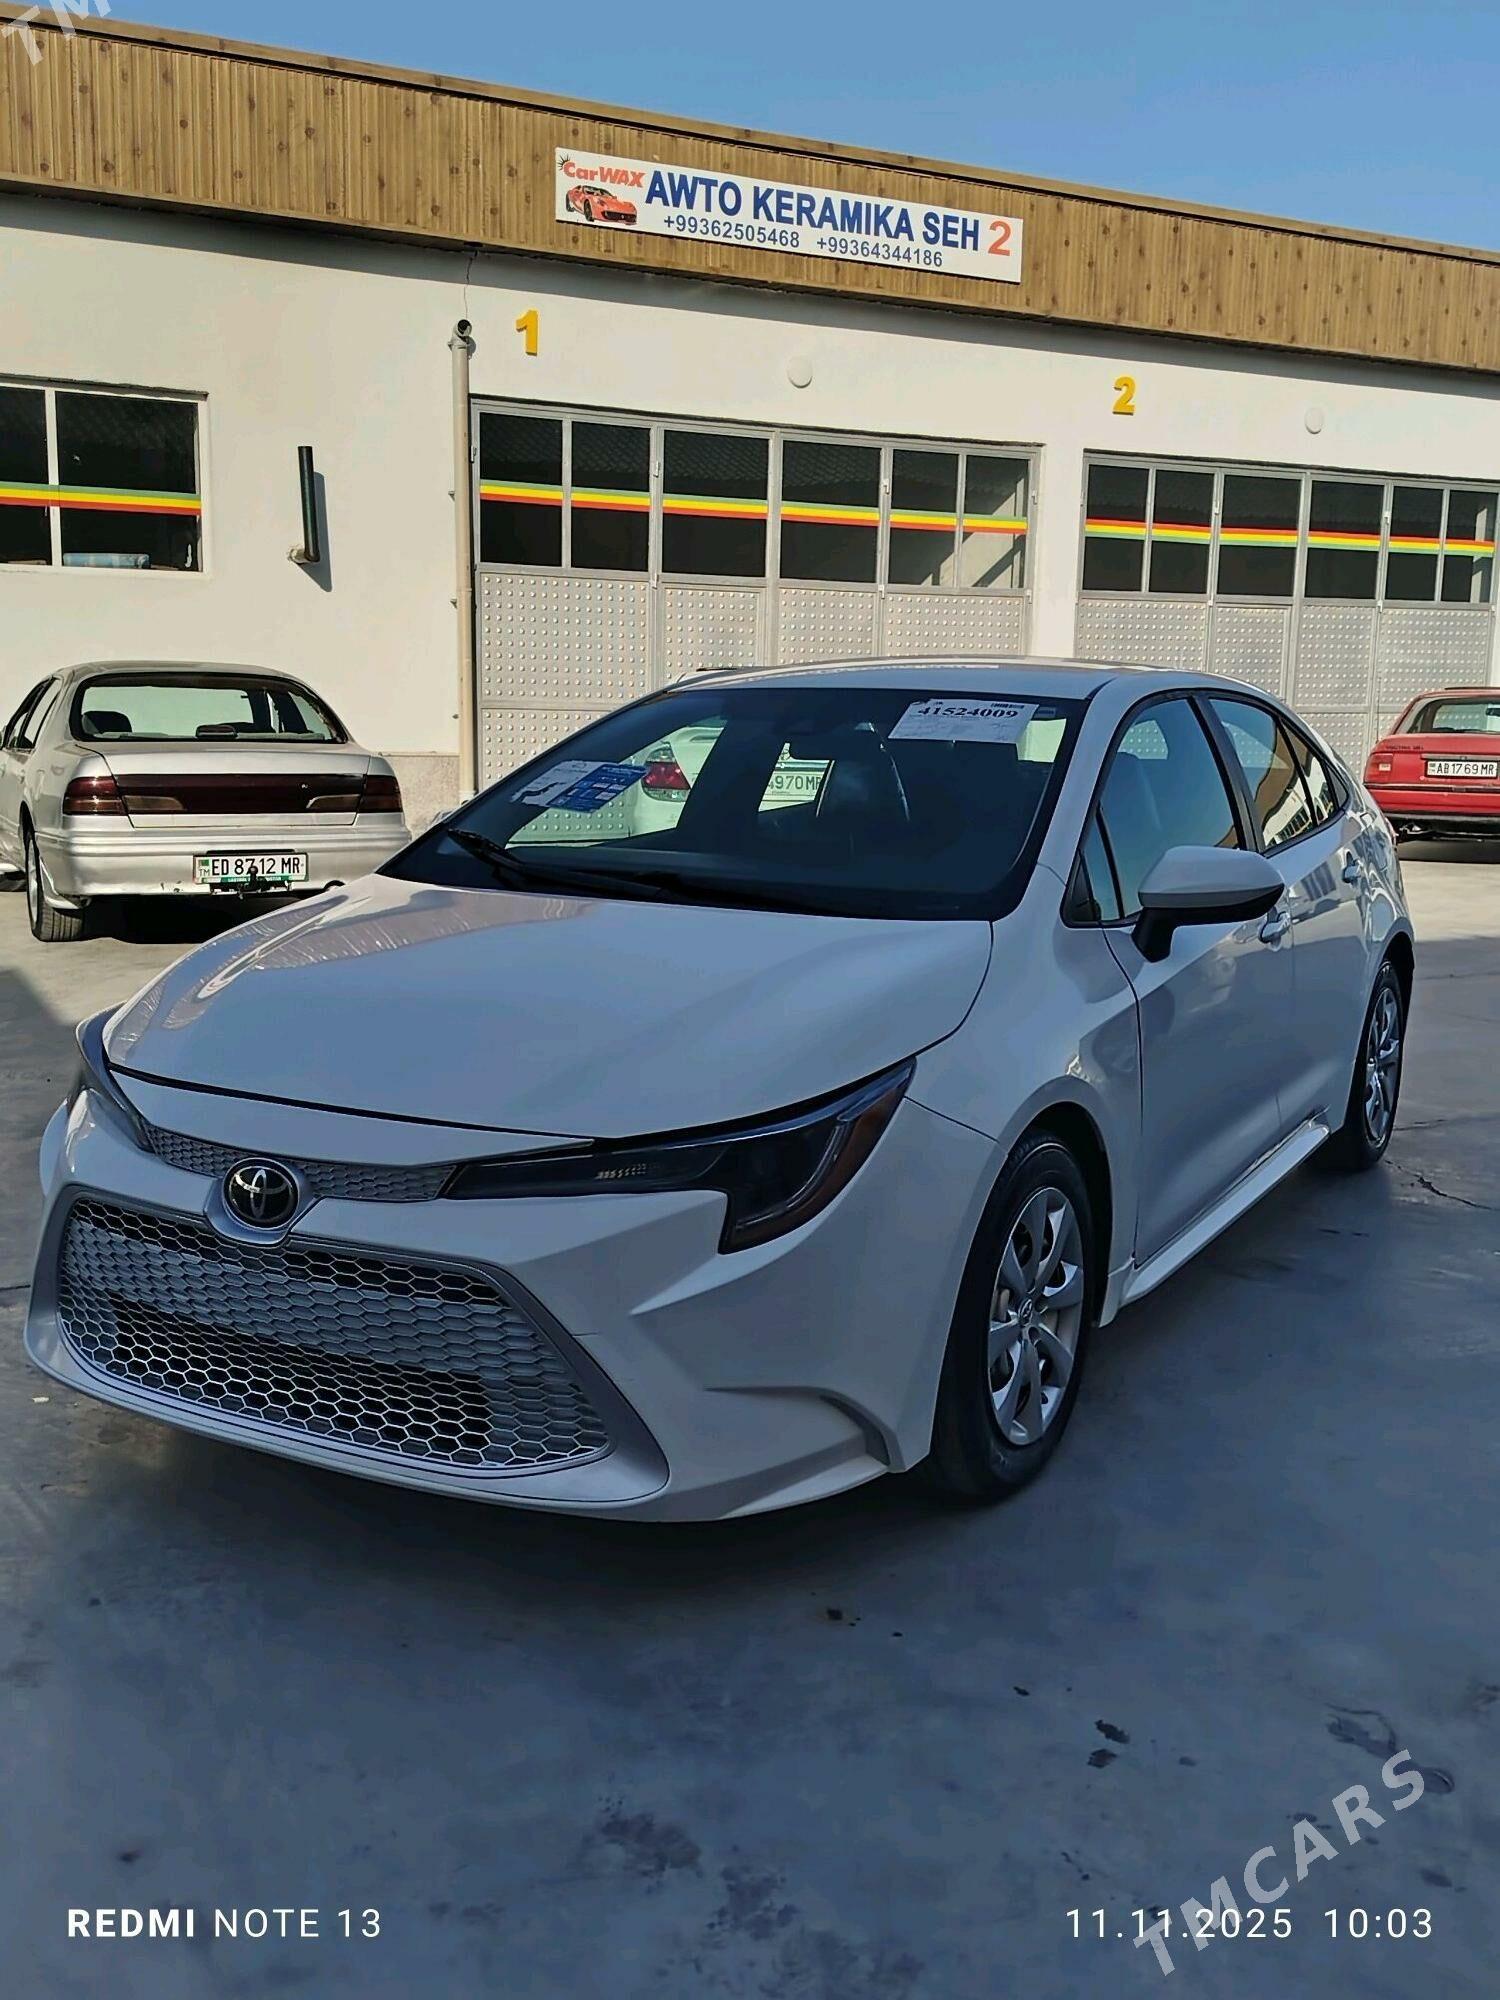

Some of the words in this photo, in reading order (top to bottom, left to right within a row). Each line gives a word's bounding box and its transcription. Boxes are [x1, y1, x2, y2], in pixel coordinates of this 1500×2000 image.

[645, 170, 742, 216] AWTO
[753, 186, 915, 242] KERAMIKA
[922, 211, 980, 251] SEH
[987, 220, 1012, 257] 2
[663, 214, 800, 248] +99362505468
[816, 236, 943, 267] +99364344186
[515, 309, 539, 357] 1
[1112, 376, 1136, 416] 2
[918, 706, 1019, 719] 41524009
[212, 859, 229, 876] ED
[281, 857, 300, 874] MR
